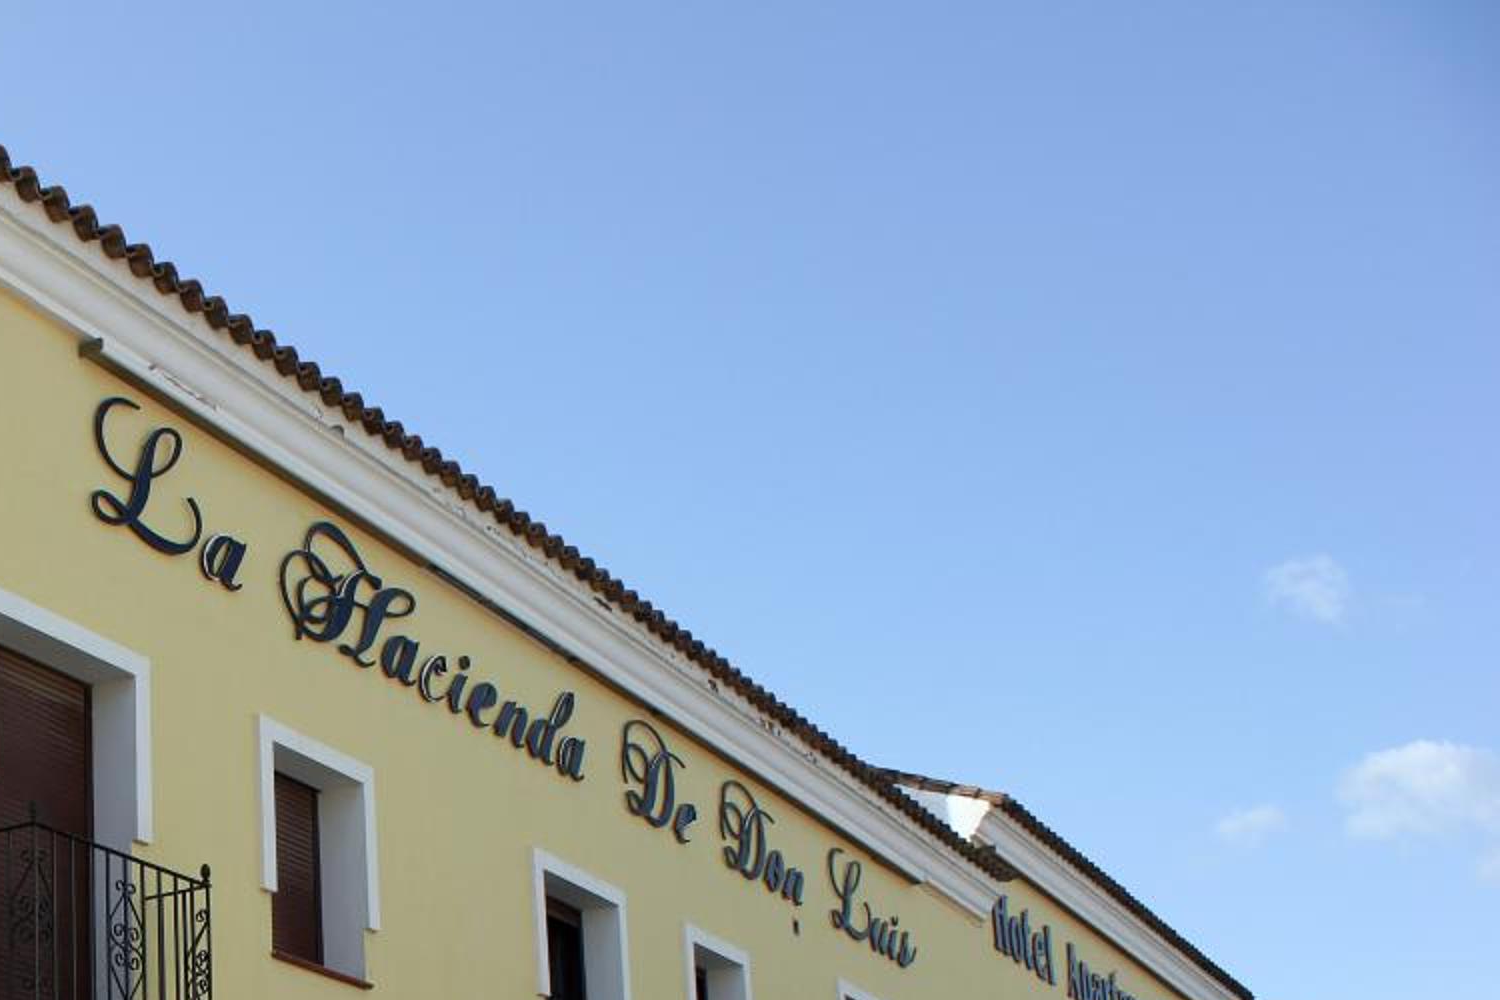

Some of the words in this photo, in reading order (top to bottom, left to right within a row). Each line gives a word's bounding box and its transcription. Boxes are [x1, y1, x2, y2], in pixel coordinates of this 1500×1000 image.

[91, 396, 244, 592] La
[279, 521, 585, 781] Hacienda
[621, 719, 697, 844] De
[719, 780, 805, 906] Don
[828, 847, 916, 968] Luis
[991, 894, 1056, 986] Hotel
